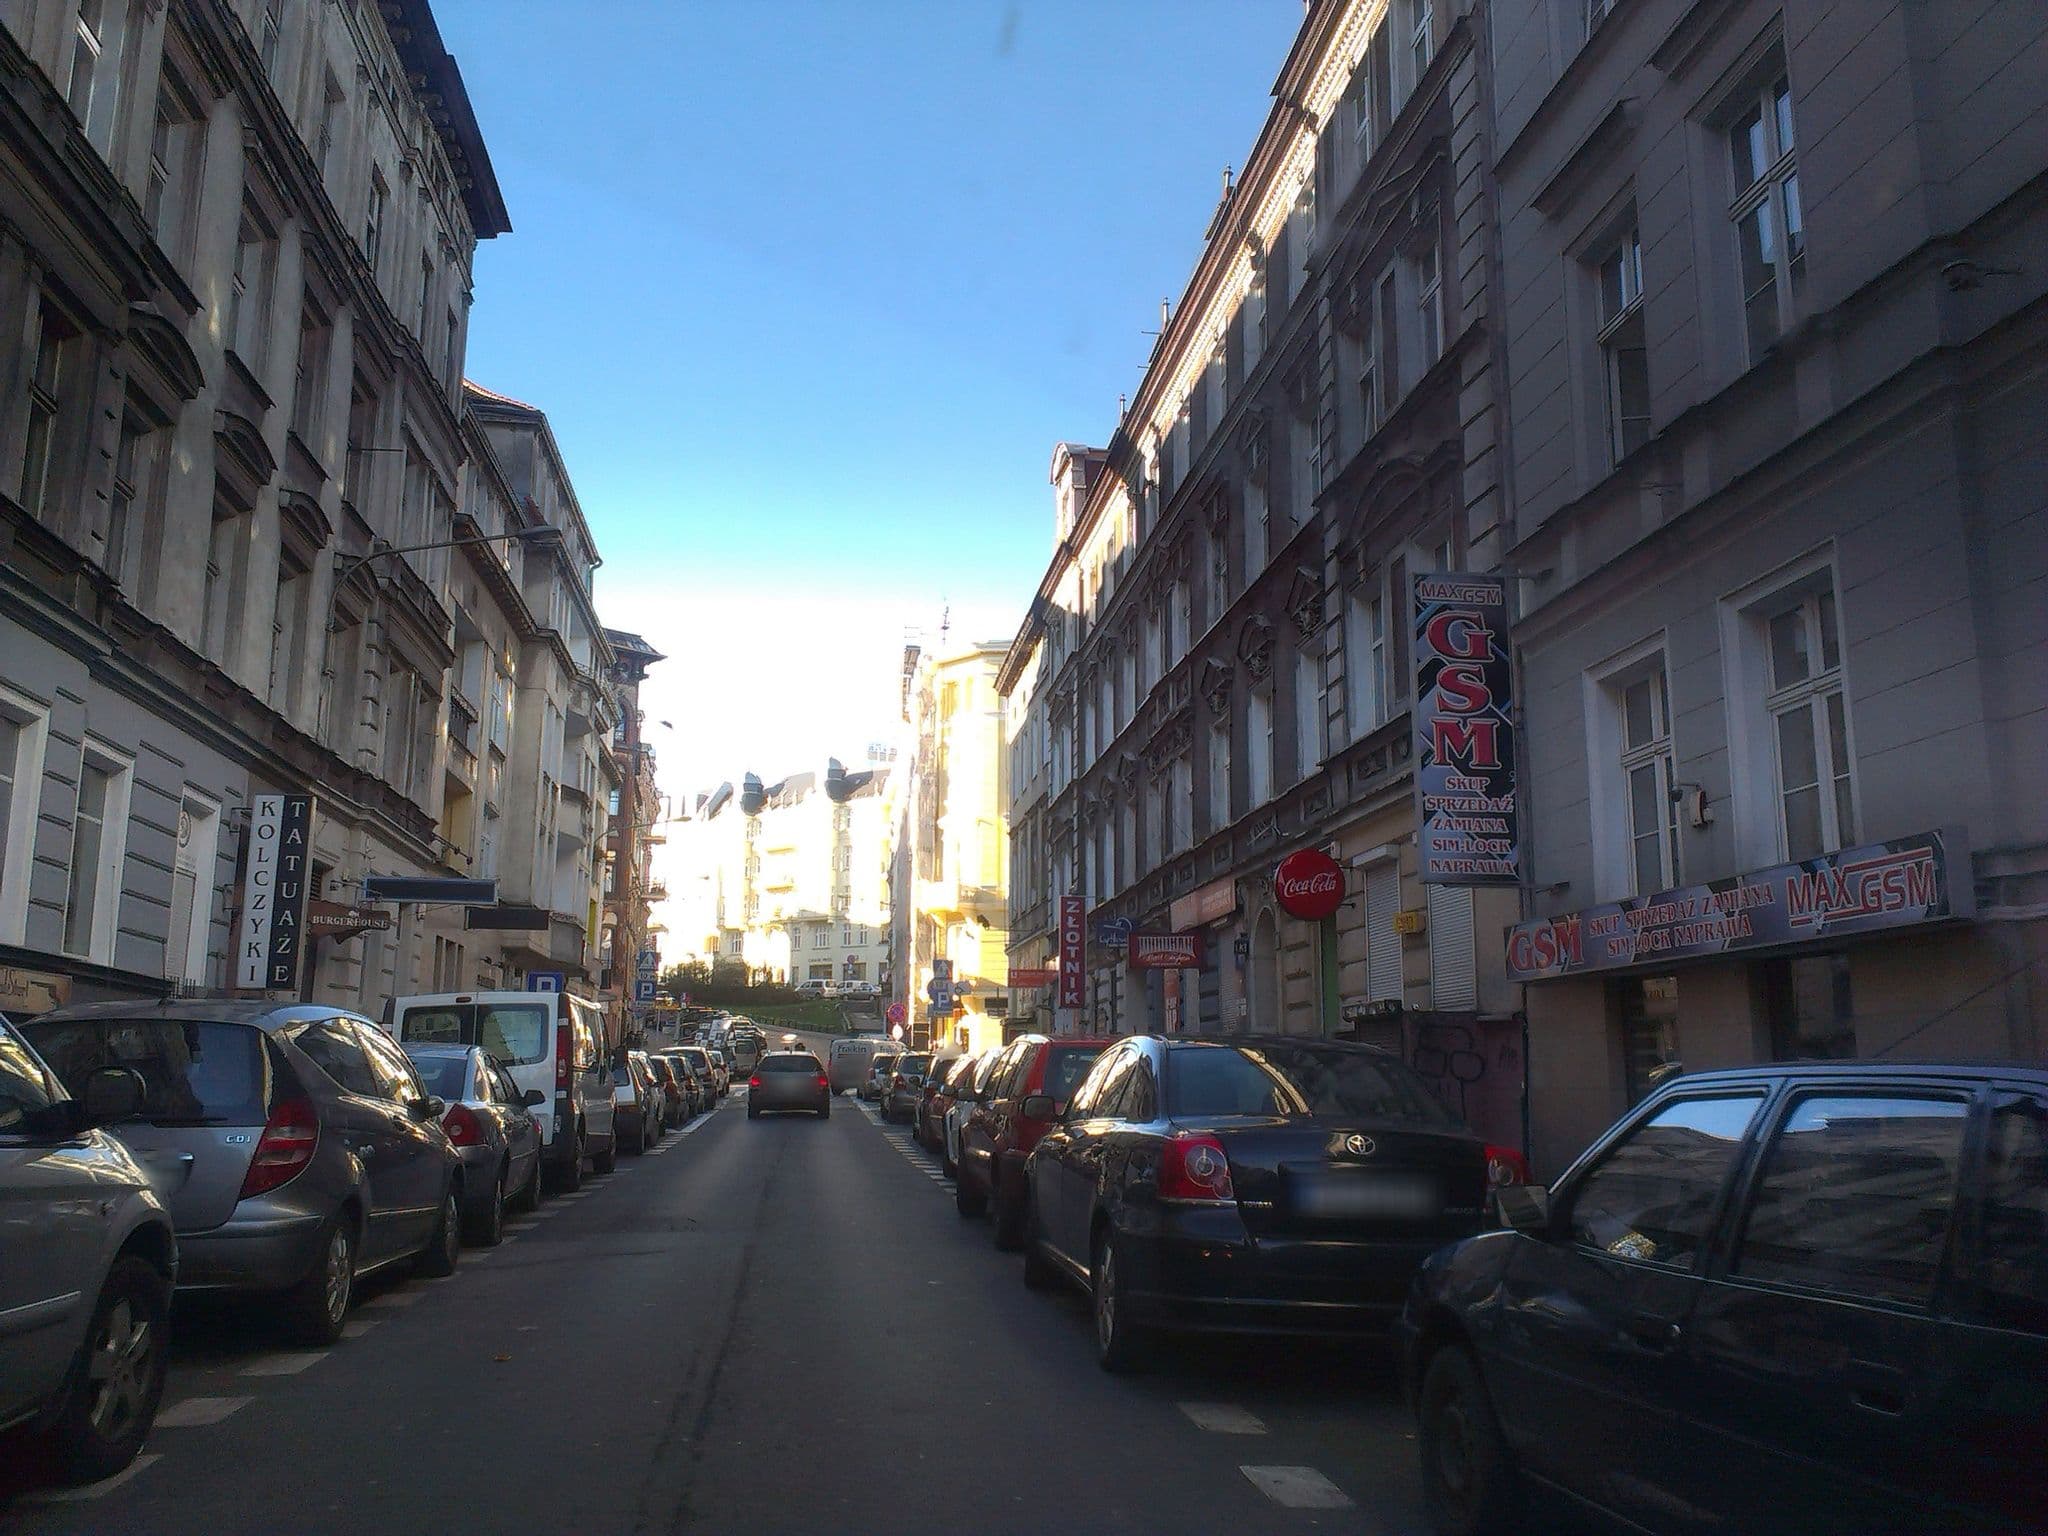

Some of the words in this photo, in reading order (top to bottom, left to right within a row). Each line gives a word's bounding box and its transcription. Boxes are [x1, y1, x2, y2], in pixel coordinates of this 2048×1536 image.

[1426, 610, 1502, 770] GSM
[1445, 776, 1490, 791] SKUP
[1425, 794, 1513, 812] SPRZEDAŻ
[1432, 817, 1509, 833] ZAMIANA
[1432, 838, 1512, 854] SIM-LOCK
[1429, 859, 1515, 875] NAPRAWA
[246, 801, 275, 981] KOLCZYKI
[274, 802, 305, 982] TATUAŻE
[1589, 913, 1620, 937] SKUP
[1624, 895, 1695, 929] SPRZEDAŻ
[1702, 882, 1776, 915] ZAMIANA
[1675, 914, 1753, 947] NAPRAWA
[1065, 901, 1081, 1004] ZŁOTNIK
[1509, 918, 1585, 972] GSM
[641, 982, 653, 998] P
[938, 992, 949, 1008] P
[226, 1135, 251, 1143] CDI
